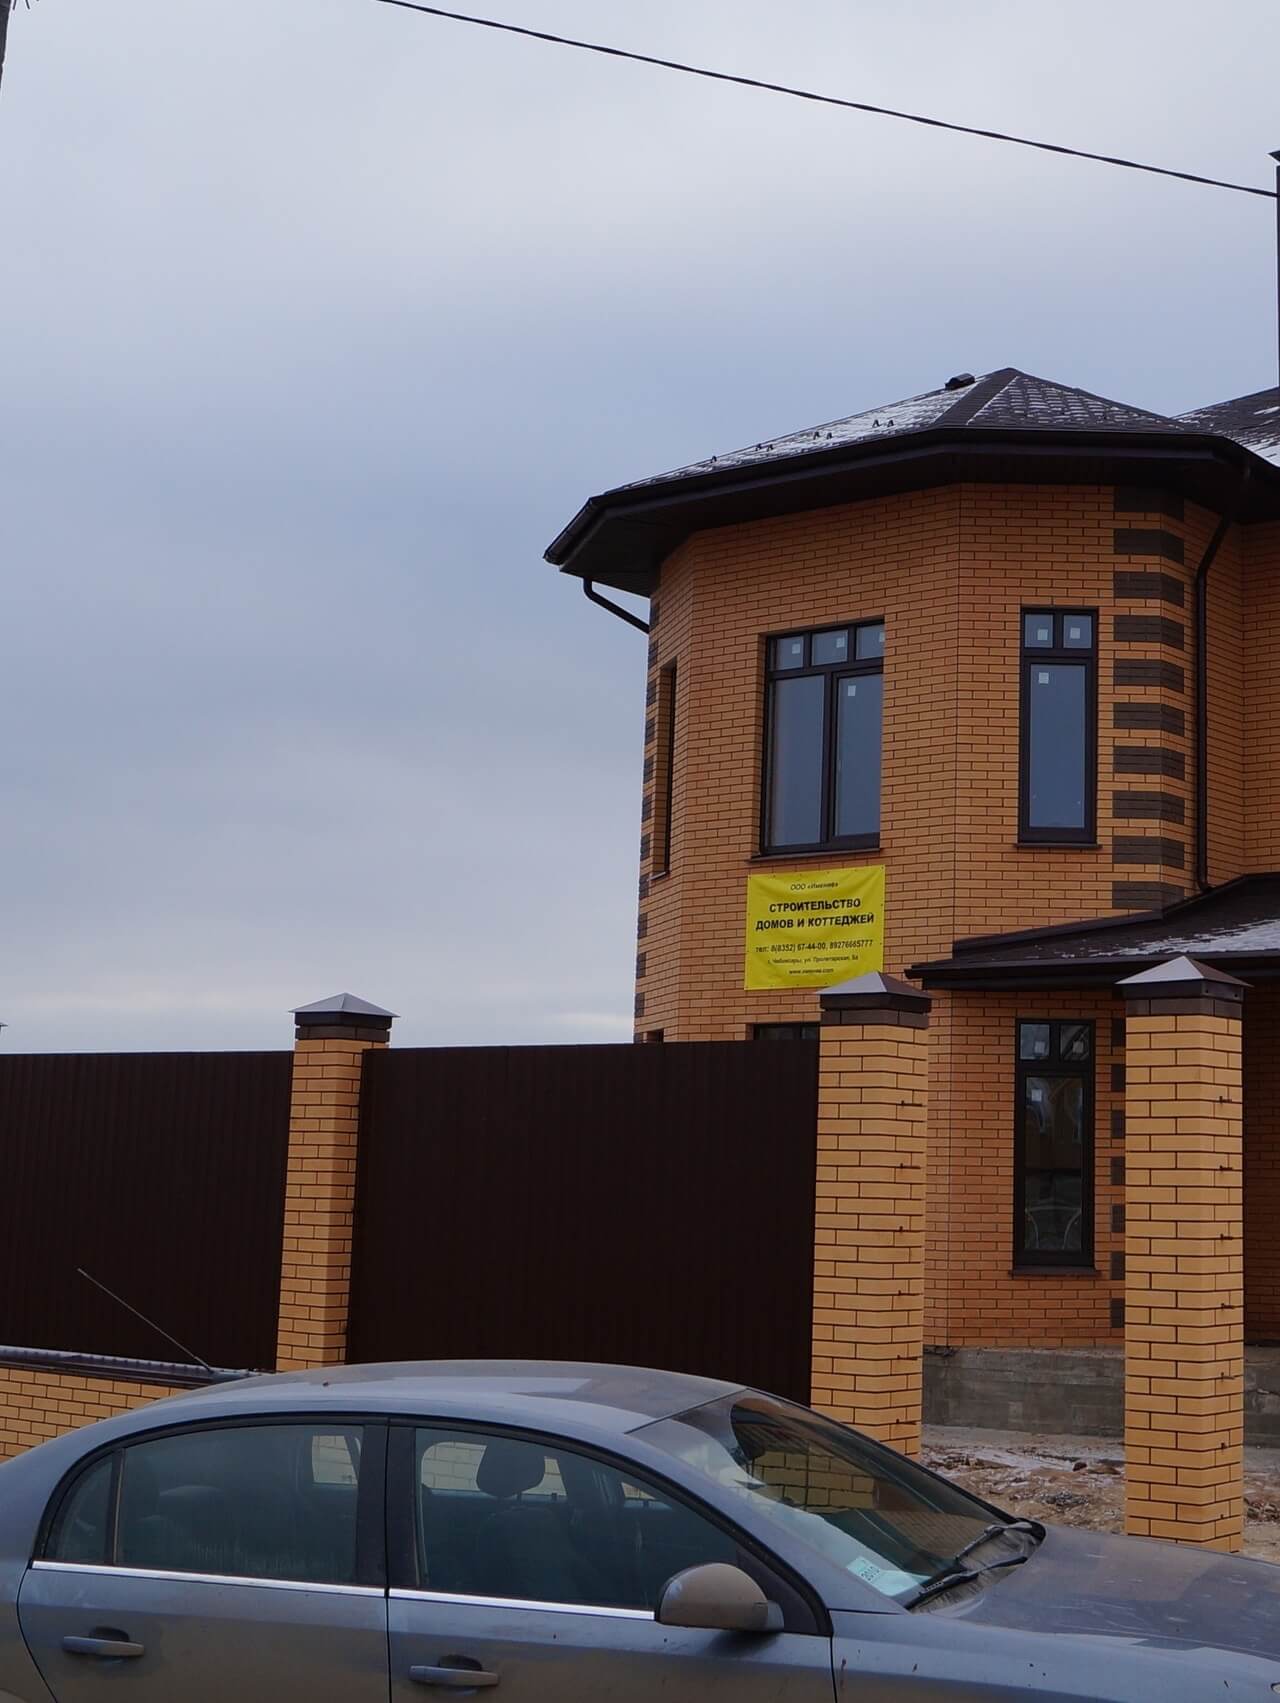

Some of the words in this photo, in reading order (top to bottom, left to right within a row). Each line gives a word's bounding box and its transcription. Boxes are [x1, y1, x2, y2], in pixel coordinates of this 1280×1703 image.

[770, 898, 860, 913] СТРОИТЕЛЬСТВО
[756, 919, 793, 931] ДОМОВ
[797, 918, 804, 927] И
[807, 913, 874, 927] КОТТЕДЖЕЙ
